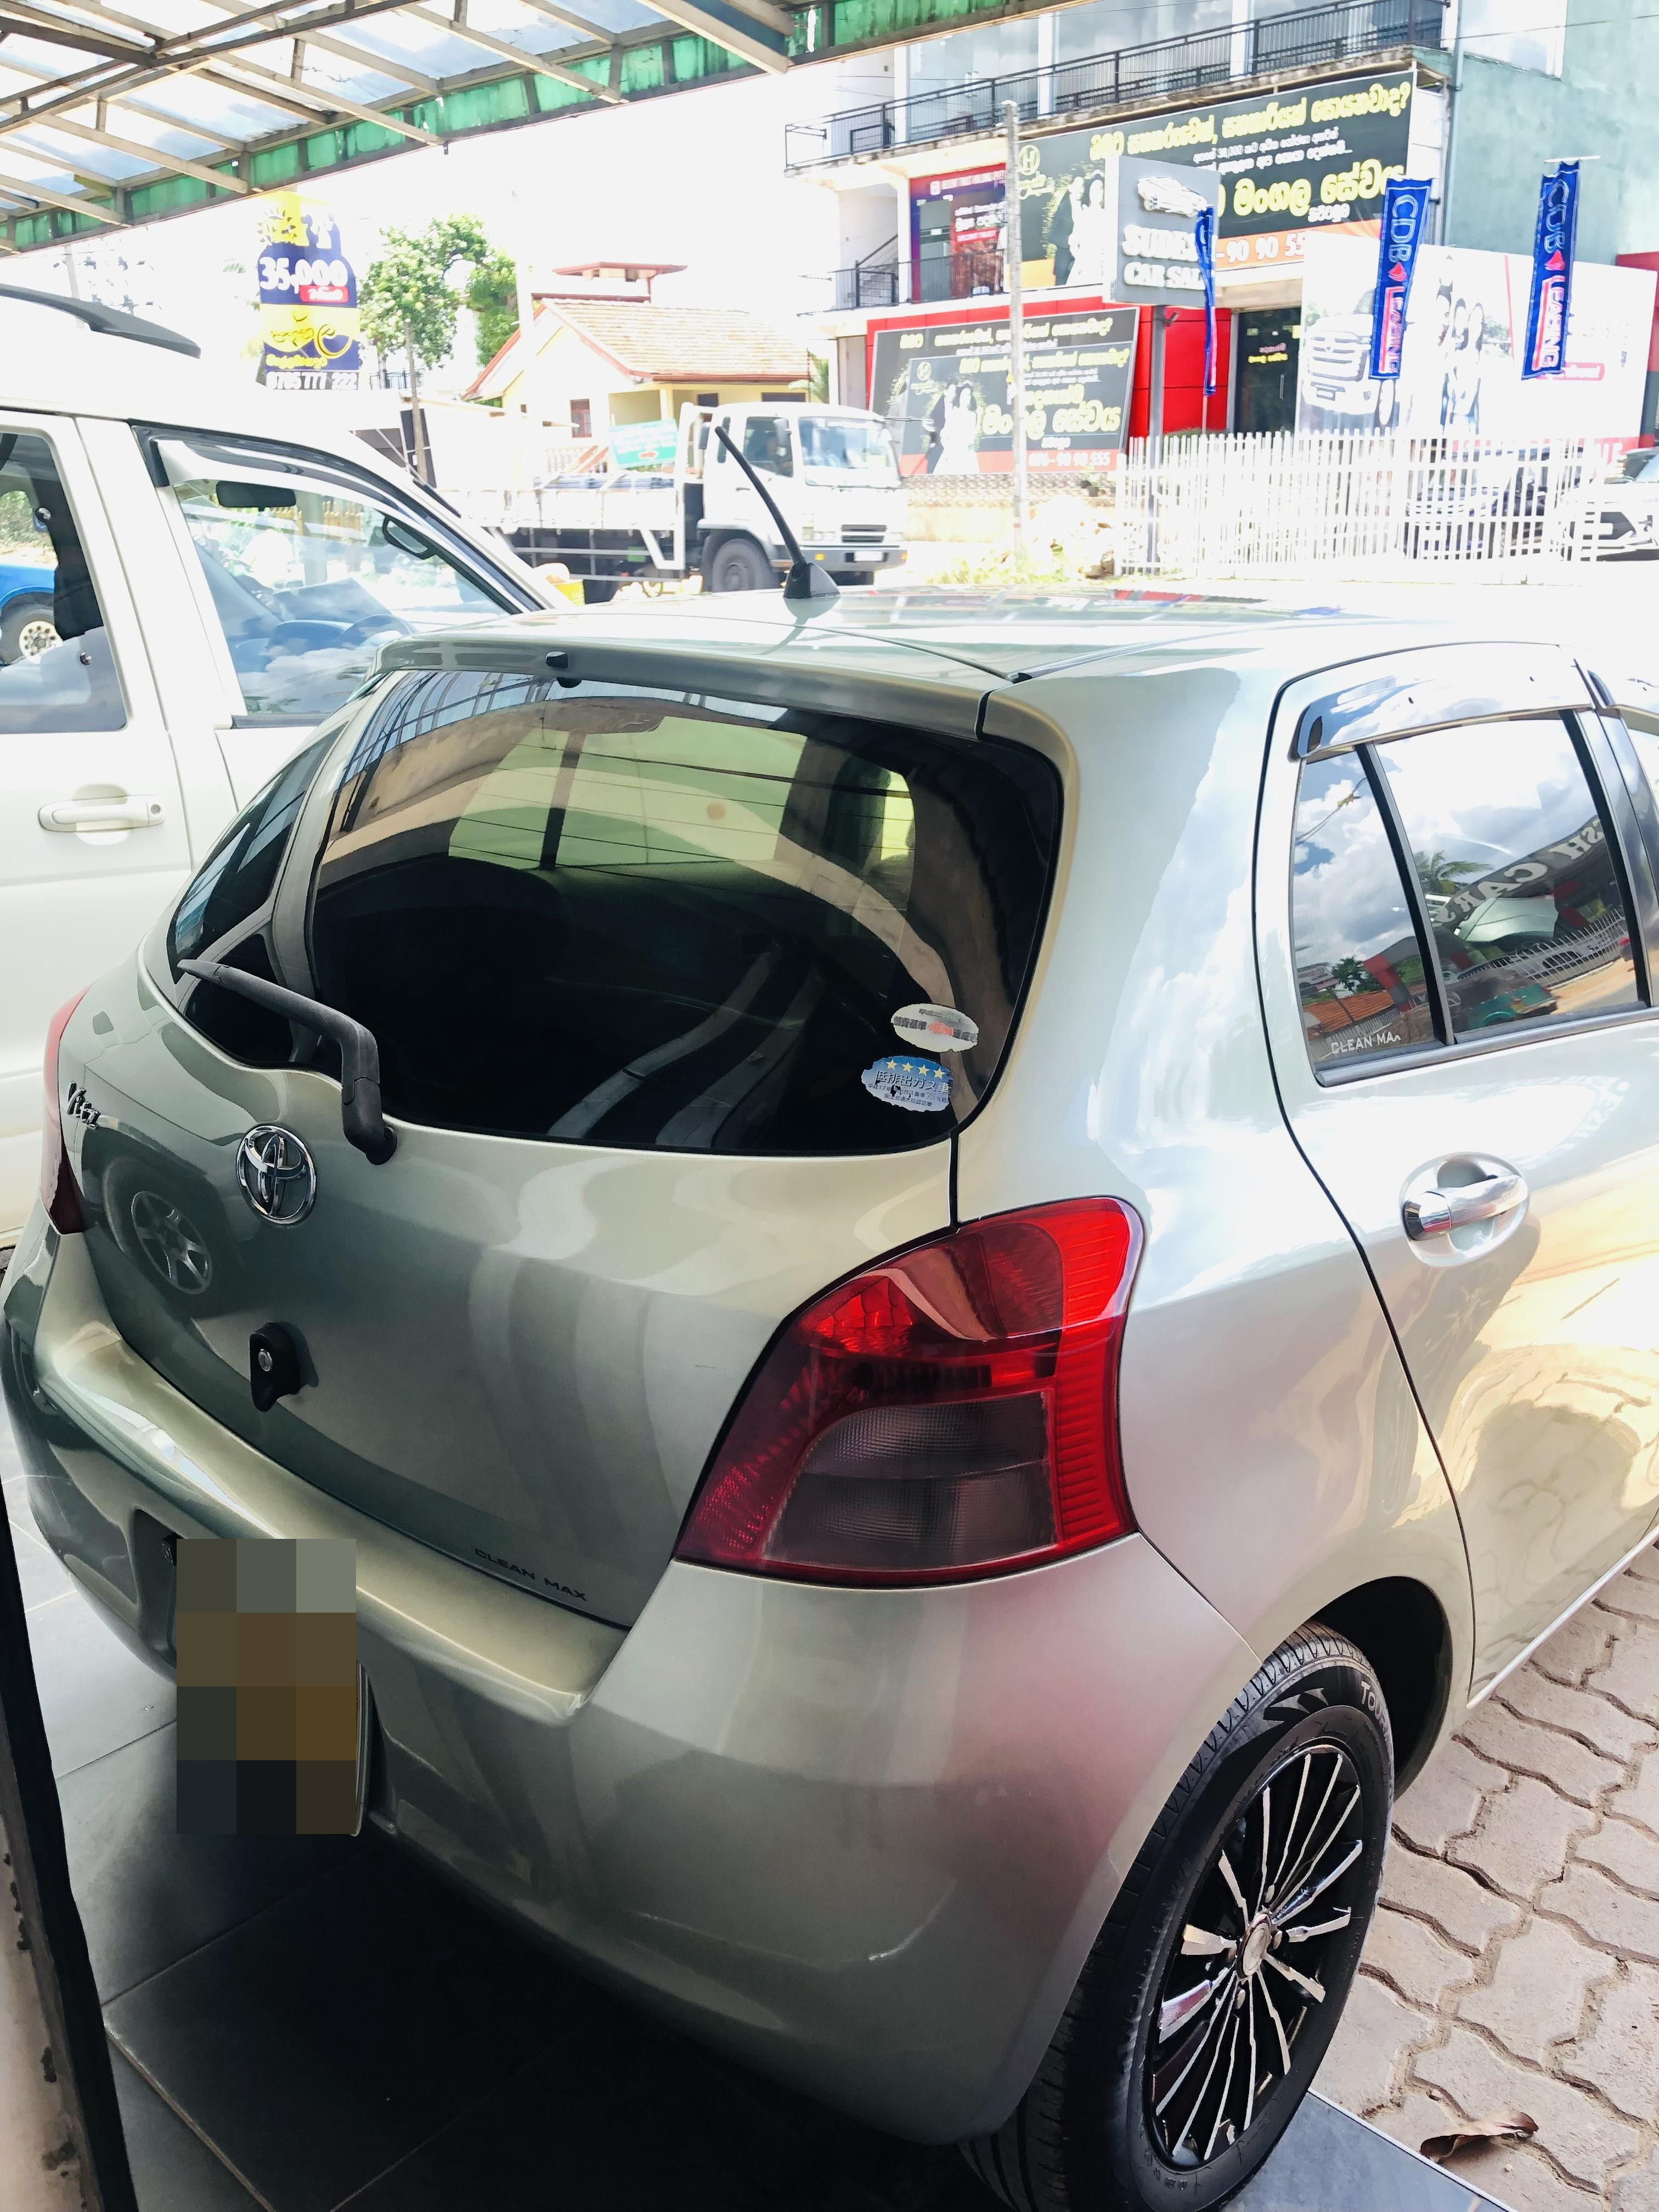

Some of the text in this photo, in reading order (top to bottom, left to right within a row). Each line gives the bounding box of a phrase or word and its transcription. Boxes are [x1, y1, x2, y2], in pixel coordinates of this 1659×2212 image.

[1388, 194, 1419, 263] CDB
[1255, 235, 1279, 261] 90
[259, 257, 348, 294] 35,000
[1124, 262, 1215, 290] CAR SAL
[1331, 1035, 1373, 1054] CLEAN
[875, 1070, 951, 1094] 低排出ガス車
[544, 1577, 587, 1601] MAX
